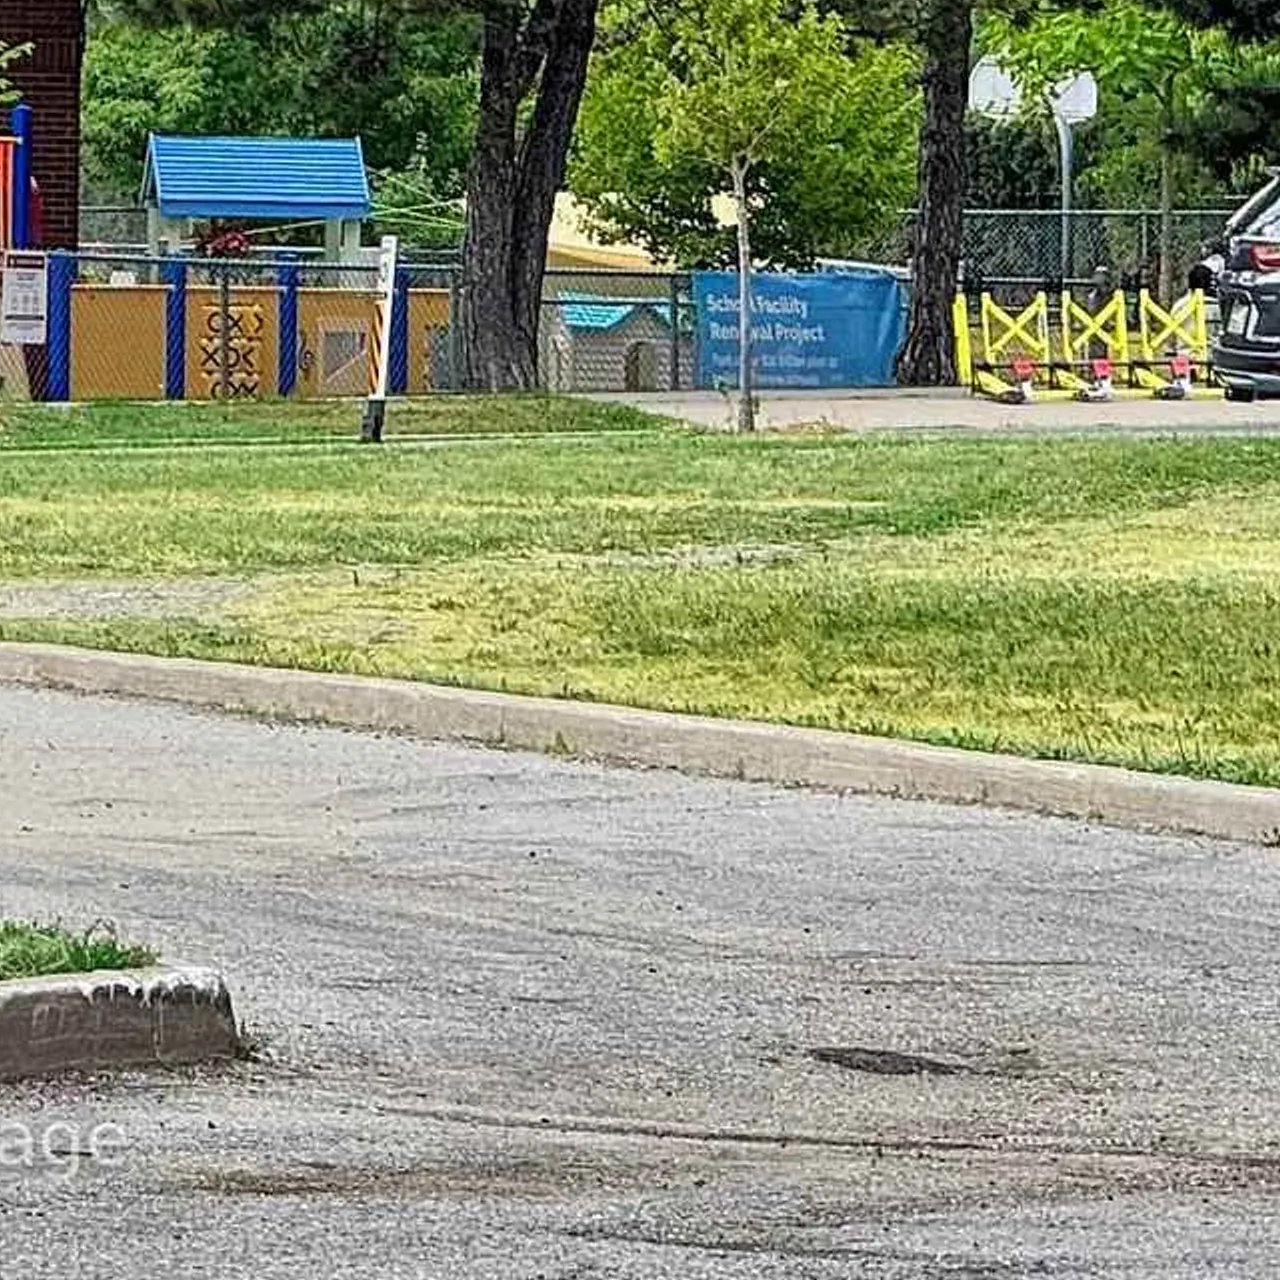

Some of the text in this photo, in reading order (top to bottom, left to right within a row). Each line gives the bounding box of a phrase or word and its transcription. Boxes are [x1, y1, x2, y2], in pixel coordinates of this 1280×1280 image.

[706, 293, 808, 319] Schol Facility
[709, 322, 826, 345] Renwal Project
